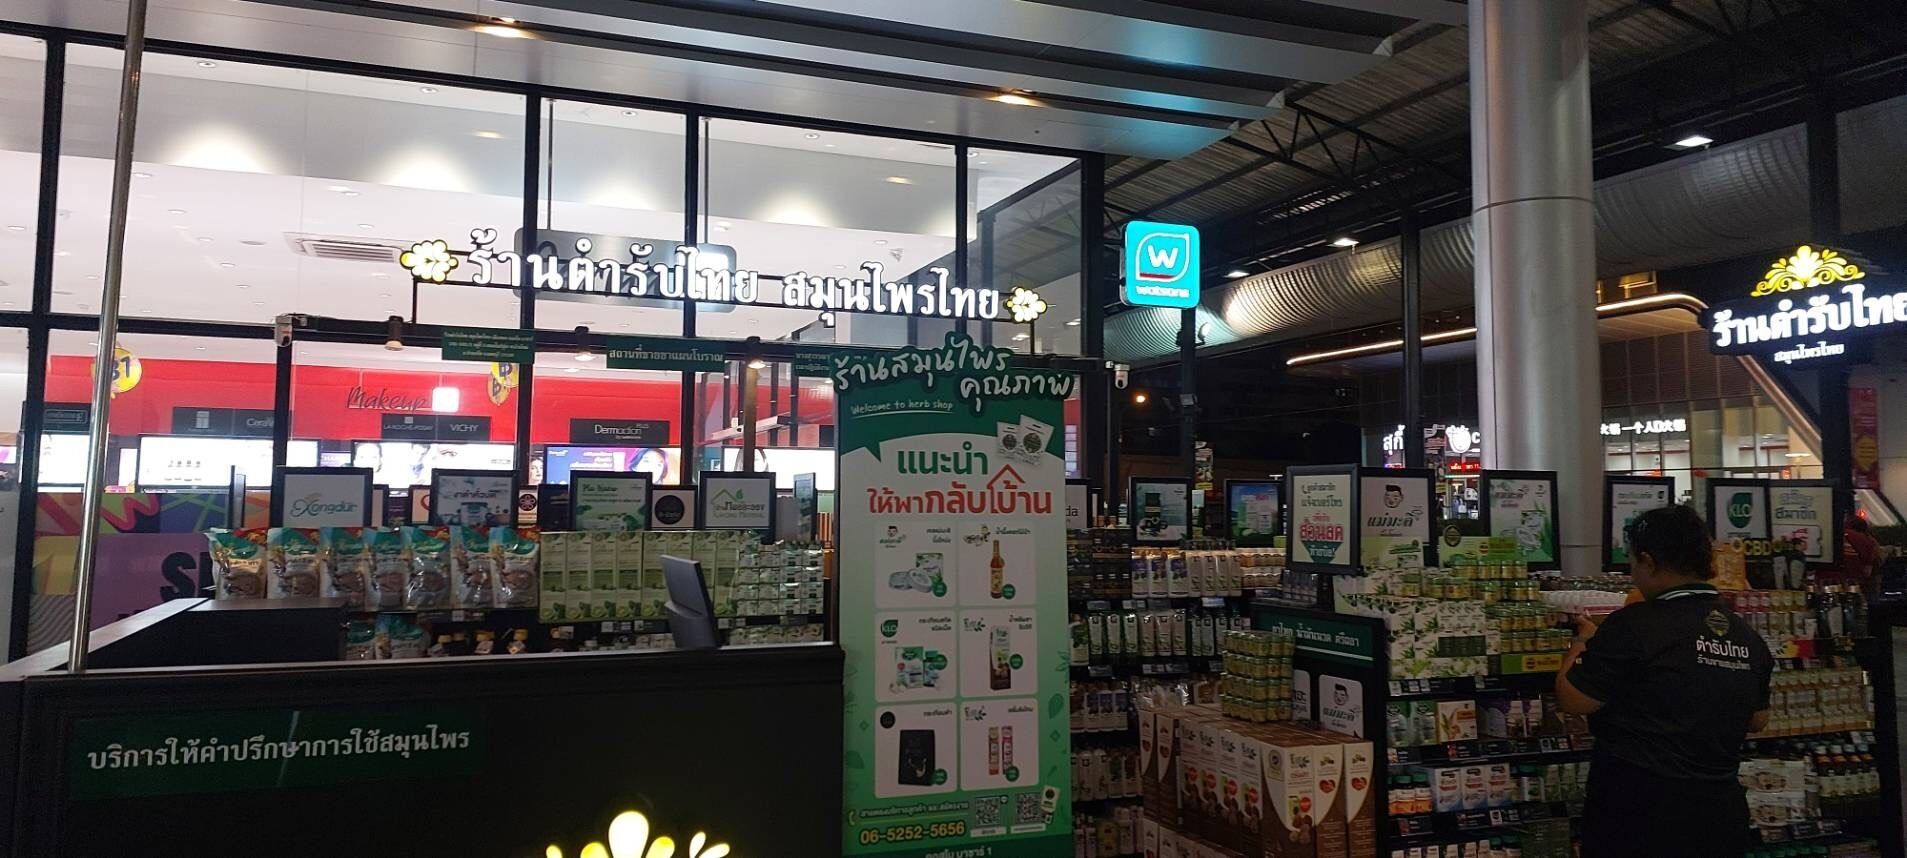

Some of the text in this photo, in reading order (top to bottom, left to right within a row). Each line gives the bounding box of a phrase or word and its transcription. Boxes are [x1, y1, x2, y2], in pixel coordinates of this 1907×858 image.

[467, 228, 1000, 327] ร้านตำรับไทย สมุนไพรไทย
[1712, 284, 1907, 347] ร้านตำรับไทย
[609, 344, 724, 362] สถานที่ขายยาแผนโบราณ
[834, 336, 1012, 390] ร้านสมุนไพร
[1774, 341, 1844, 364] สมุนไพรไทย
[345, 386, 425, 411] Makeup
[960, 374, 1071, 413] คุณภาพ
[851, 400, 953, 415] Welcome to herb shop
[449, 423, 479, 432] VICHY
[1383, 424, 1406, 456] สุกี้
[898, 441, 989, 475] แนะนำ
[1775, 507, 1817, 520] สมาชิก
[1696, 635, 1750, 659] ตำรับไทย
[87, 723, 470, 770] บริการให้คำปรึกษาการใช้สมุนไพร
[860, 822, 966, 845] 06-5252-5656
[986, 846, 993, 856] 1
